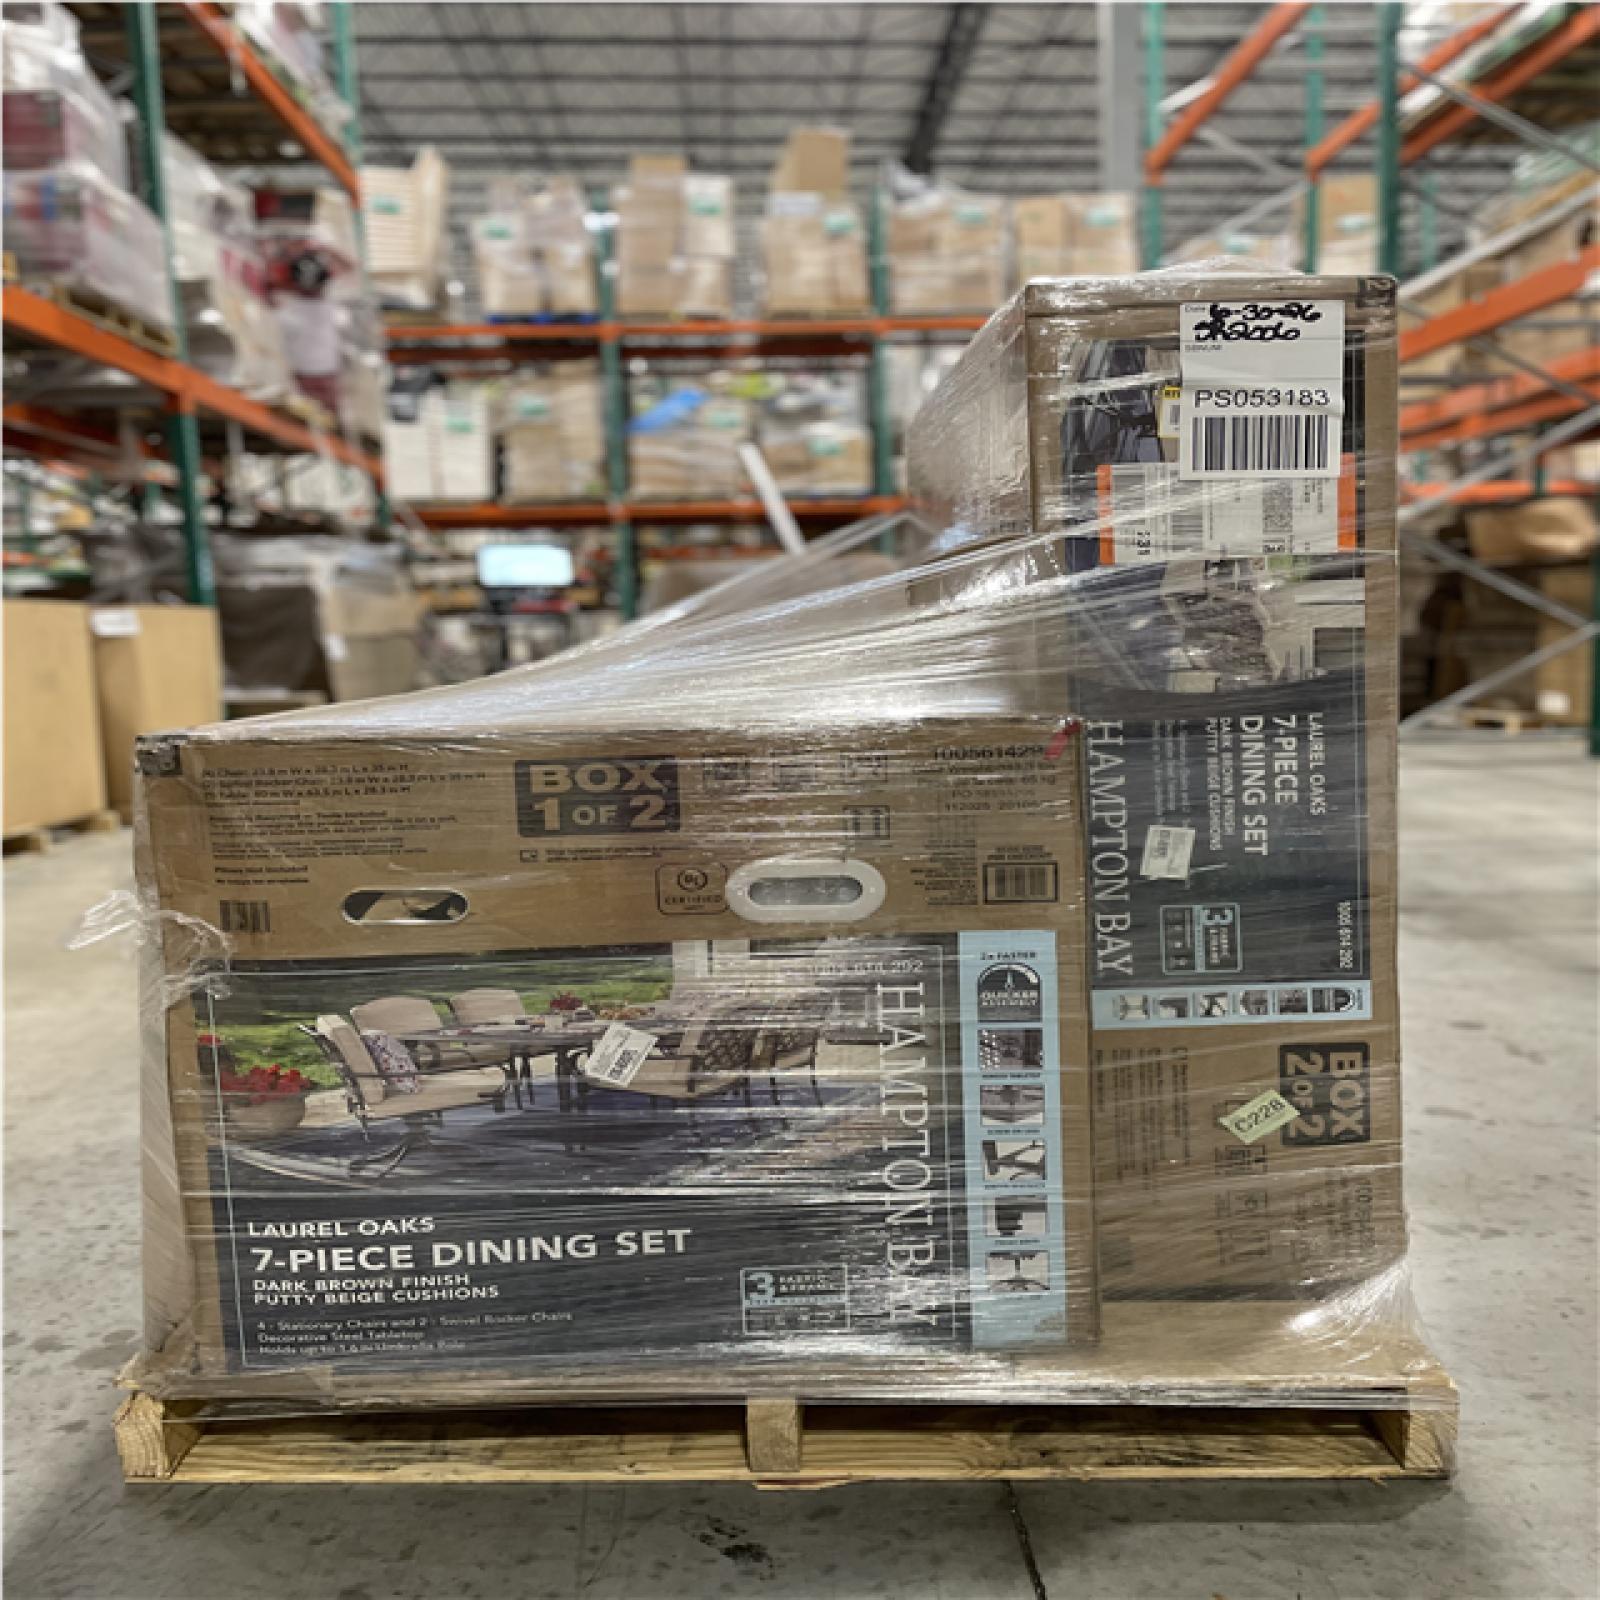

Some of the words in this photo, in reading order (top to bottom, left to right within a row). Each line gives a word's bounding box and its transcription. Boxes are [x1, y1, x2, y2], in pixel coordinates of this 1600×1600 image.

[1195, 389, 1330, 407] PS053183
[1309, 712, 1325, 770] LAUREL
[1240, 715, 1266, 805] DINING
[1273, 714, 1298, 804] 7-PIECE
[528, 761, 664, 793] BOX
[533, 797, 561, 830] 1
[572, 804, 618, 826] OF
[630, 795, 667, 828] 2
[1088, 720, 1129, 900] HAMPTON
[1244, 814, 1268, 855] SET
[1095, 912, 1133, 976] BAY
[1285, 1052, 1325, 1076] 2
[877, 982, 934, 1226] HAMPTON
[1292, 1080, 1314, 1108] OF
[1329, 1051, 1365, 1137] BOX
[1289, 1114, 1327, 1138] 2
[248, 1221, 349, 1238] LAUREL
[358, 1216, 437, 1236] OAKS
[251, 1244, 415, 1273] 7-PIECE
[432, 1234, 598, 1268] DINING
[614, 1228, 692, 1256] SET
[254, 1279, 307, 1291] DARK
[314, 1277, 394, 1292] BROWN
[402, 1272, 470, 1289] FINISH
[254, 1292, 317, 1306] PUTTY
[324, 1292, 387, 1305] BEIGE
[392, 1284, 500, 1303] CUSHIONS
[746, 1271, 774, 1301] 3
